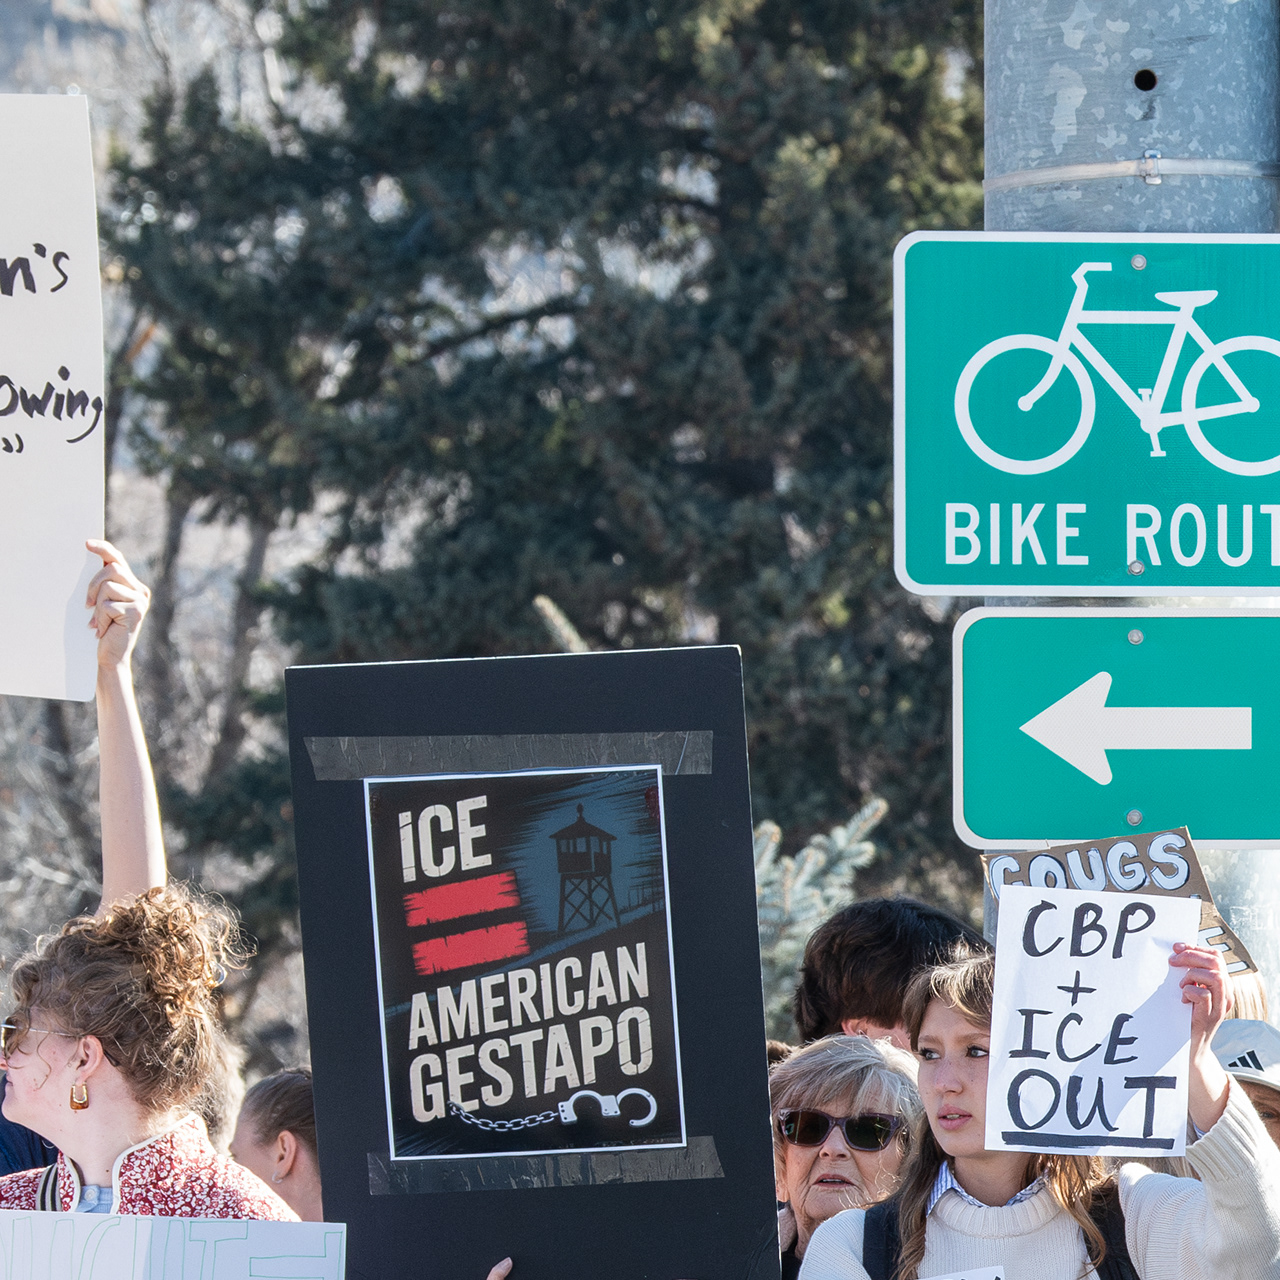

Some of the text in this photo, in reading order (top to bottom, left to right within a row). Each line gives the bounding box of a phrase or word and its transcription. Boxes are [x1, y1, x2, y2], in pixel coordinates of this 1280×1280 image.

[945, 503, 1089, 566] BIKE
[398, 794, 493, 884] ICE
[988, 831, 1192, 900] COUGS
[1022, 899, 1156, 960] CBP
[408, 941, 650, 1051] AMERICAN
[1056, 970, 1097, 1007] +
[409, 1005, 654, 1124] GESTAPO
[1008, 1008, 1139, 1065] ICE
[1006, 1067, 1178, 1139] OUT
